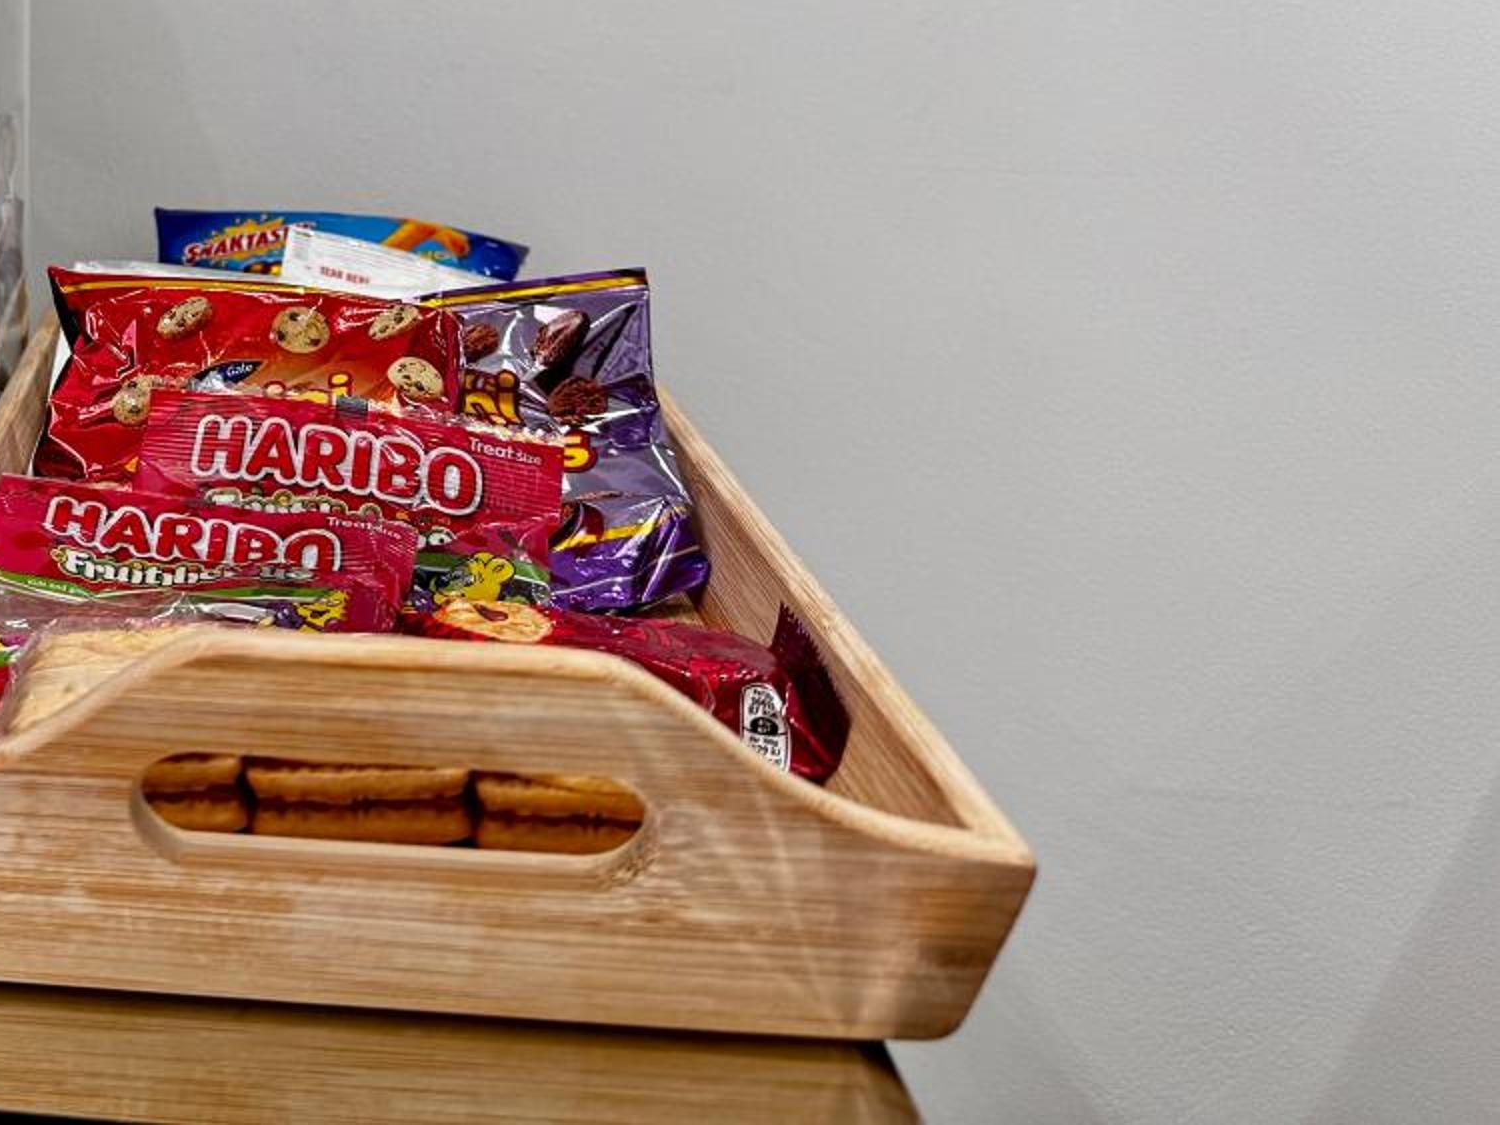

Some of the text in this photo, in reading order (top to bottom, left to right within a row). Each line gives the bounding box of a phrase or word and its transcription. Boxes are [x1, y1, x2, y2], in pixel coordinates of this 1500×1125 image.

[192, 415, 484, 516] HARIBO
[469, 436, 514, 459] Treat
[43, 495, 343, 573] HARIBO
